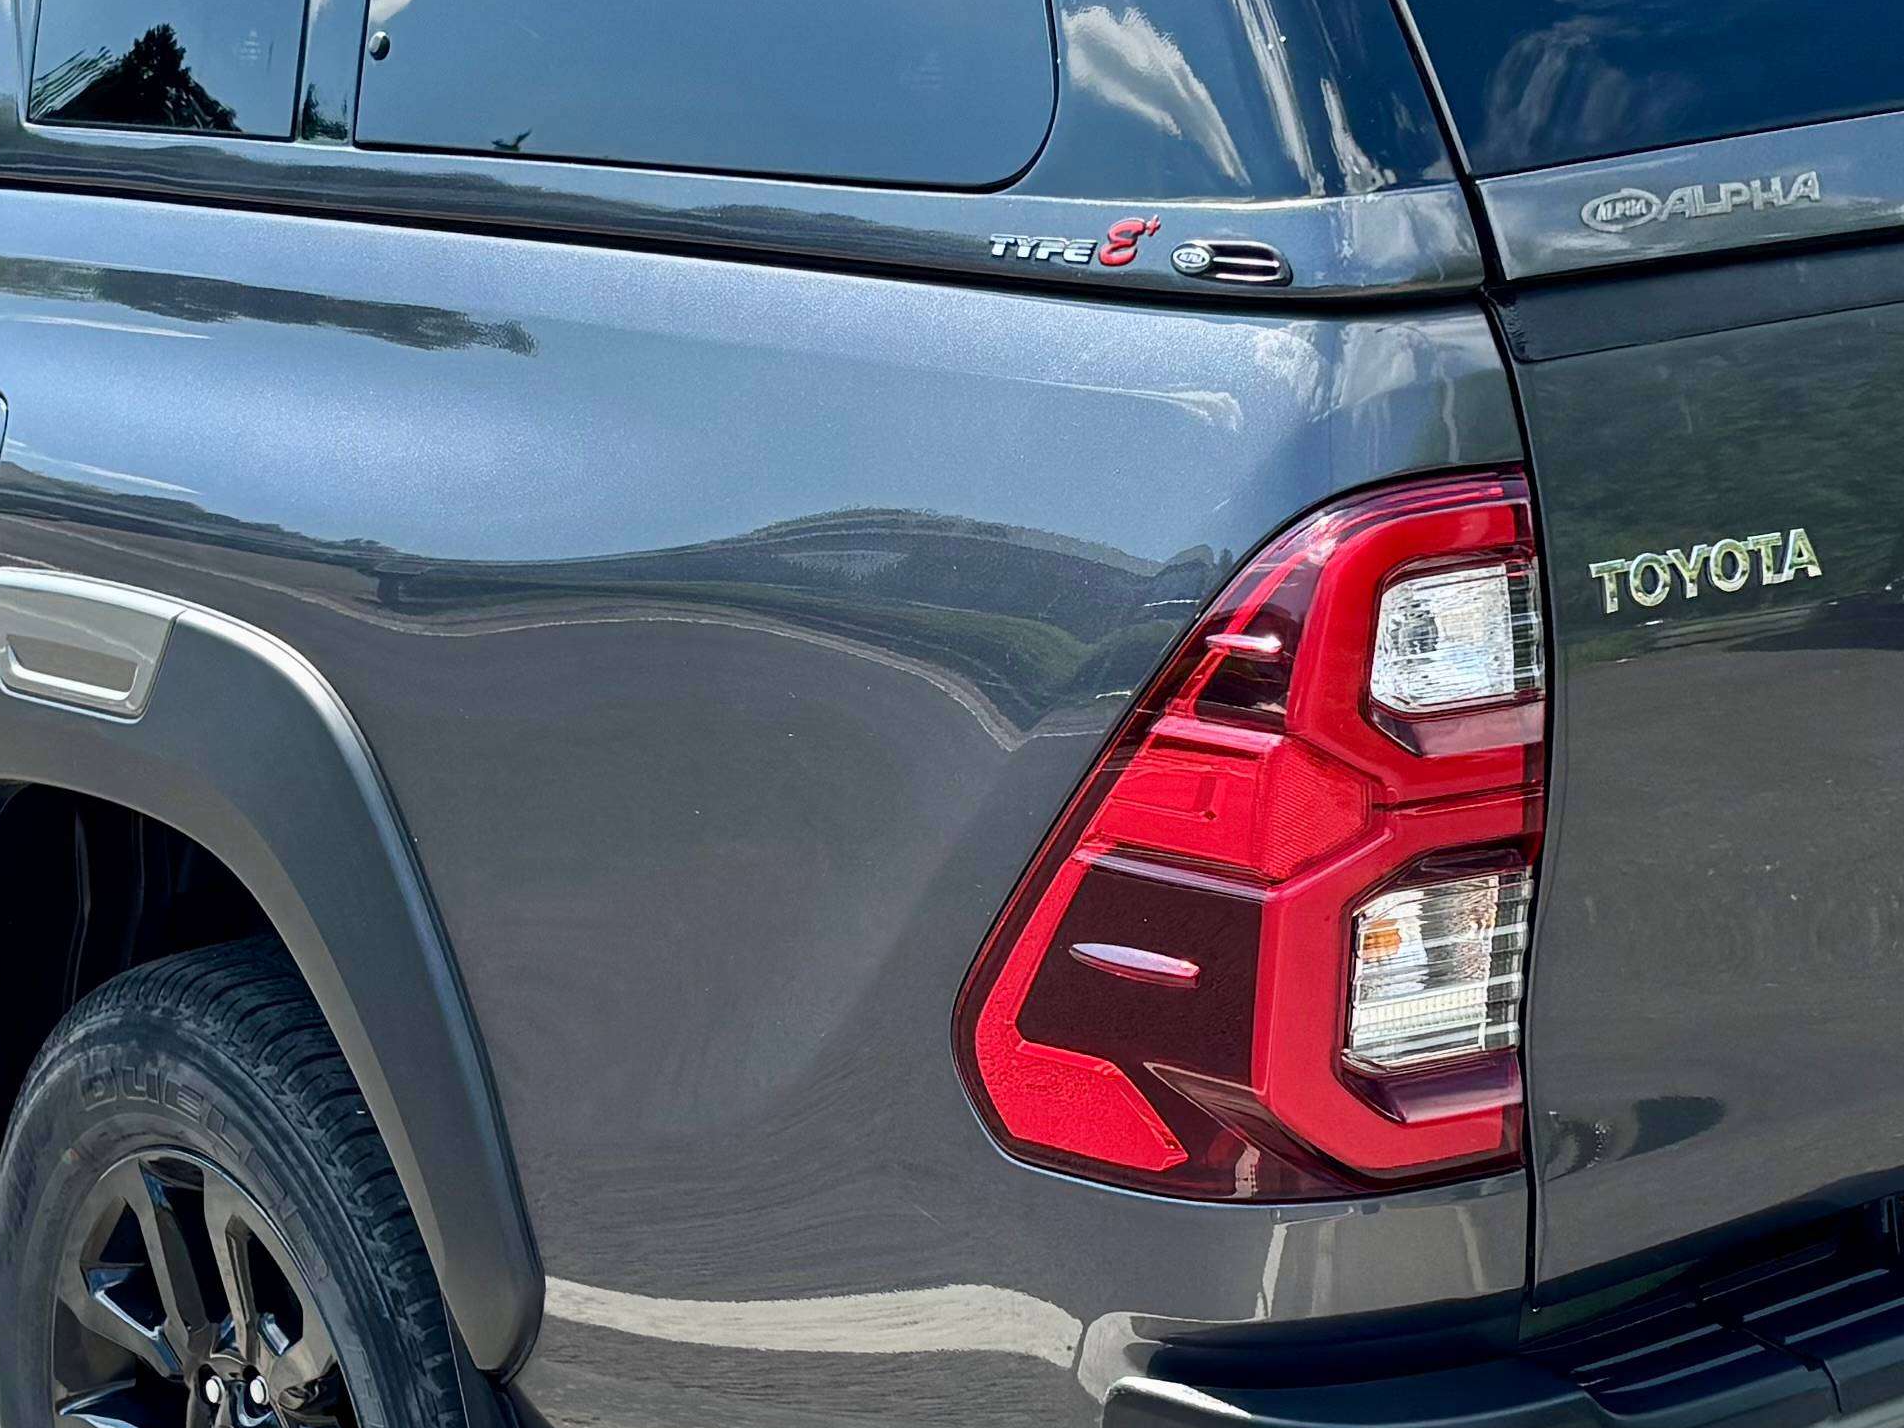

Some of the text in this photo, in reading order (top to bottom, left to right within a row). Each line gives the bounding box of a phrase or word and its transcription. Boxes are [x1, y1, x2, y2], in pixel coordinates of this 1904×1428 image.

[1657, 170, 1821, 222] ALPHA
[990, 232, 1097, 265] TYPE
[1588, 527, 1823, 614] TOYOTA
